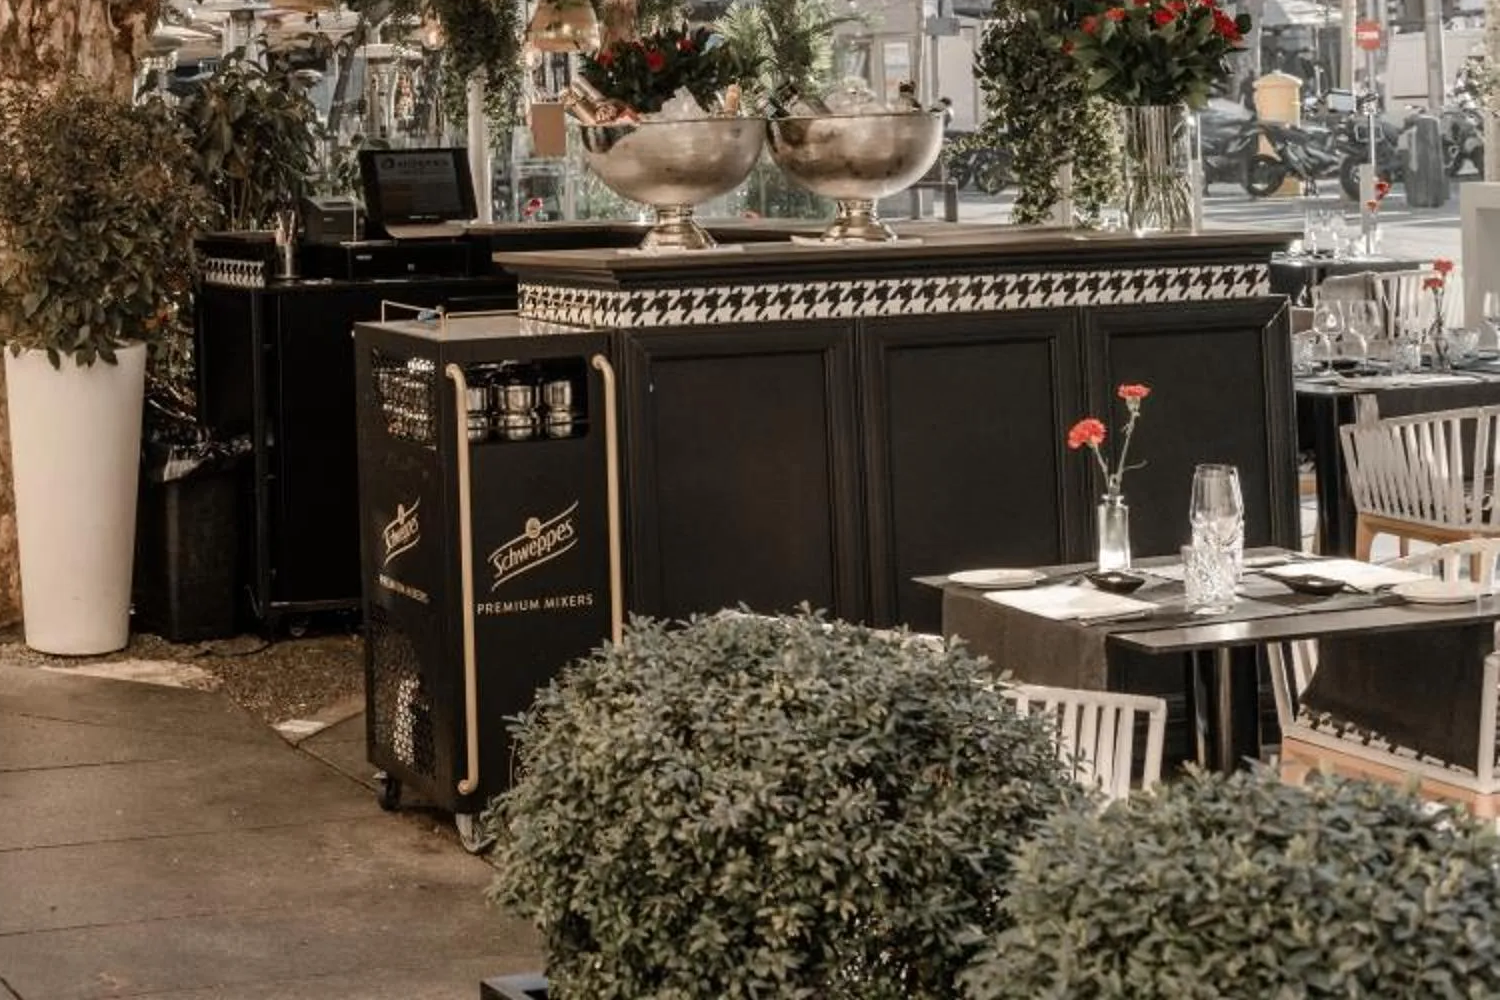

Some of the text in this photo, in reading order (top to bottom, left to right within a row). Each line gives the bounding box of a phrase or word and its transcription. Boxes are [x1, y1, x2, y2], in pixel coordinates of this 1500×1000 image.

[493, 518, 575, 579] Schweppes
[476, 593, 594, 615] PREMIUM MIXERS
